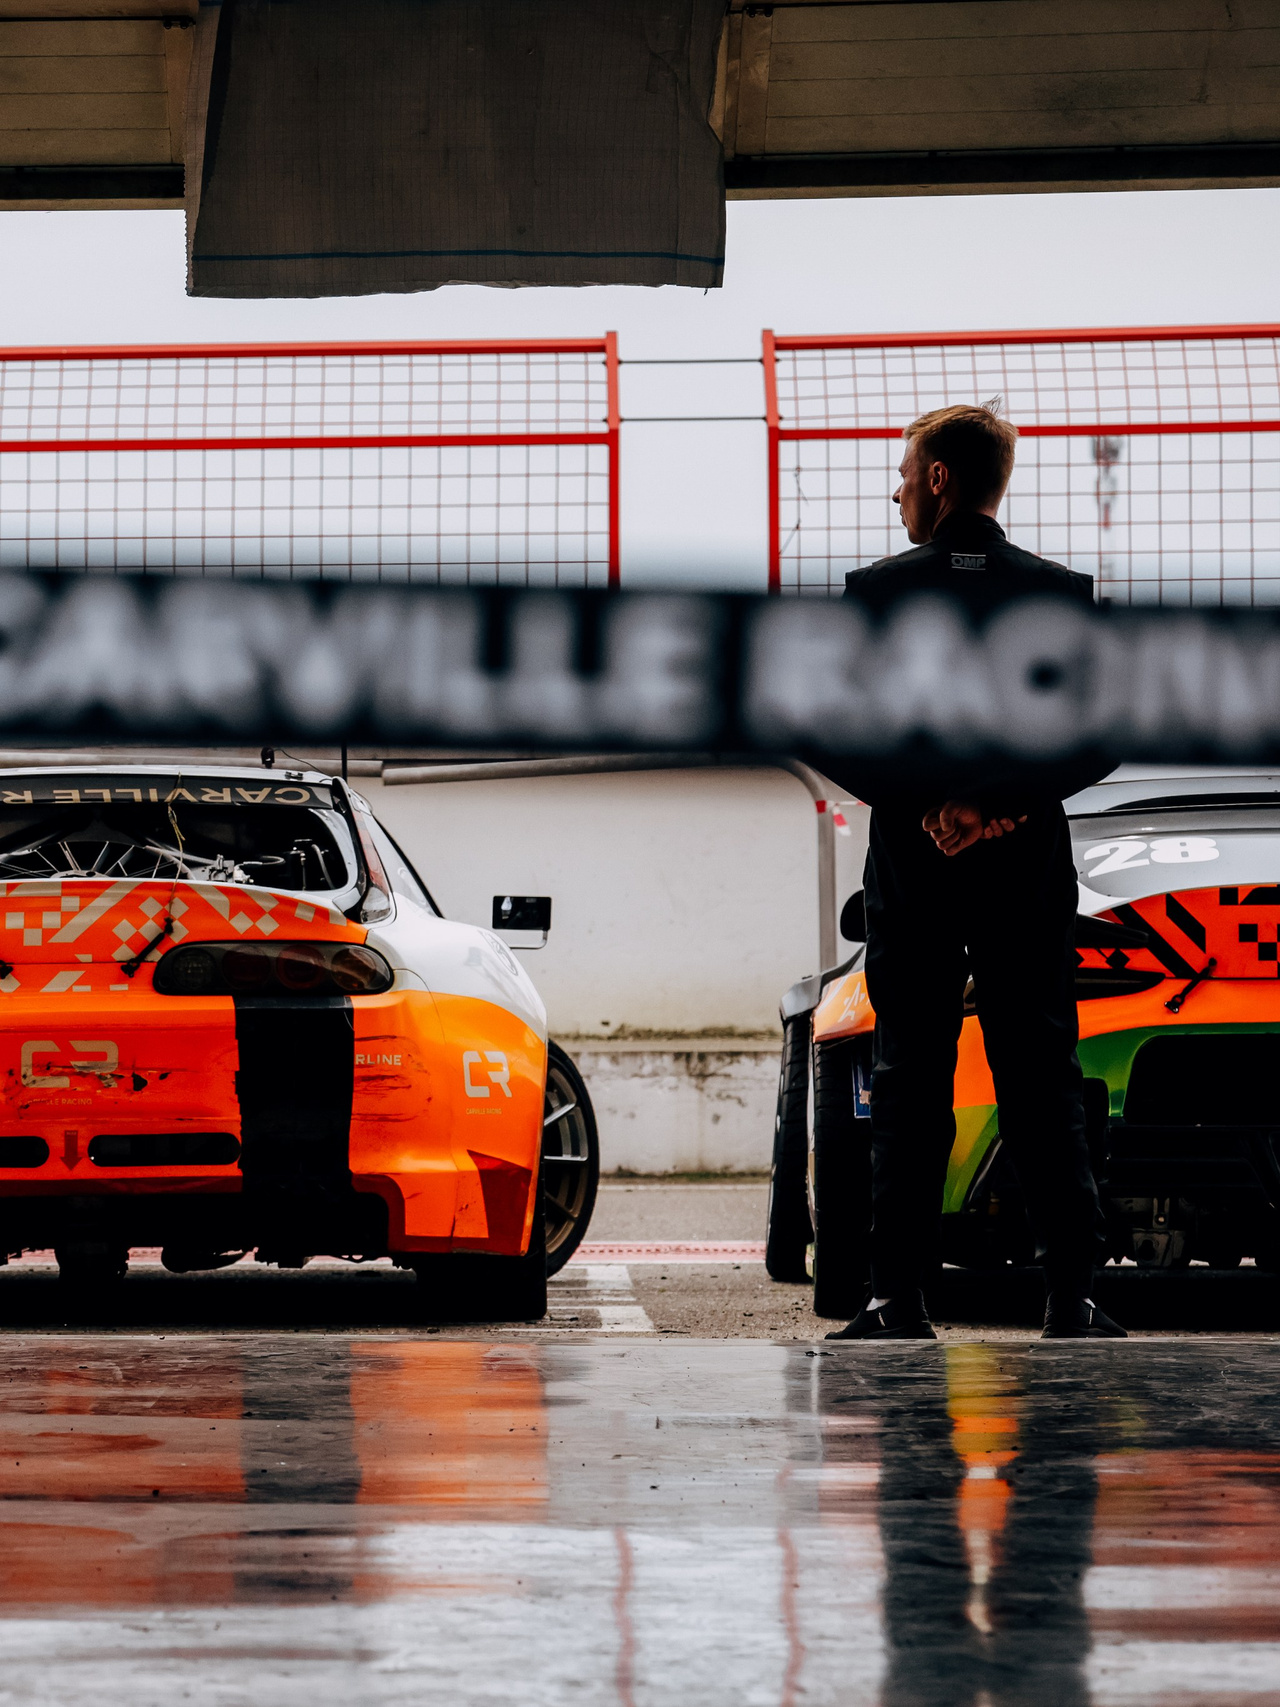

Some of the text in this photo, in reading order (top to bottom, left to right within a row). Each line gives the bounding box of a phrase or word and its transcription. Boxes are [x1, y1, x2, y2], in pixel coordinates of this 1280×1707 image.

[951, 556, 986, 568] OMP
[53, 787, 311, 804] CARVILLE
[1083, 837, 1220, 878] 28
[462, 1051, 513, 1098] CR
[61, 1098, 93, 1106] RACING
